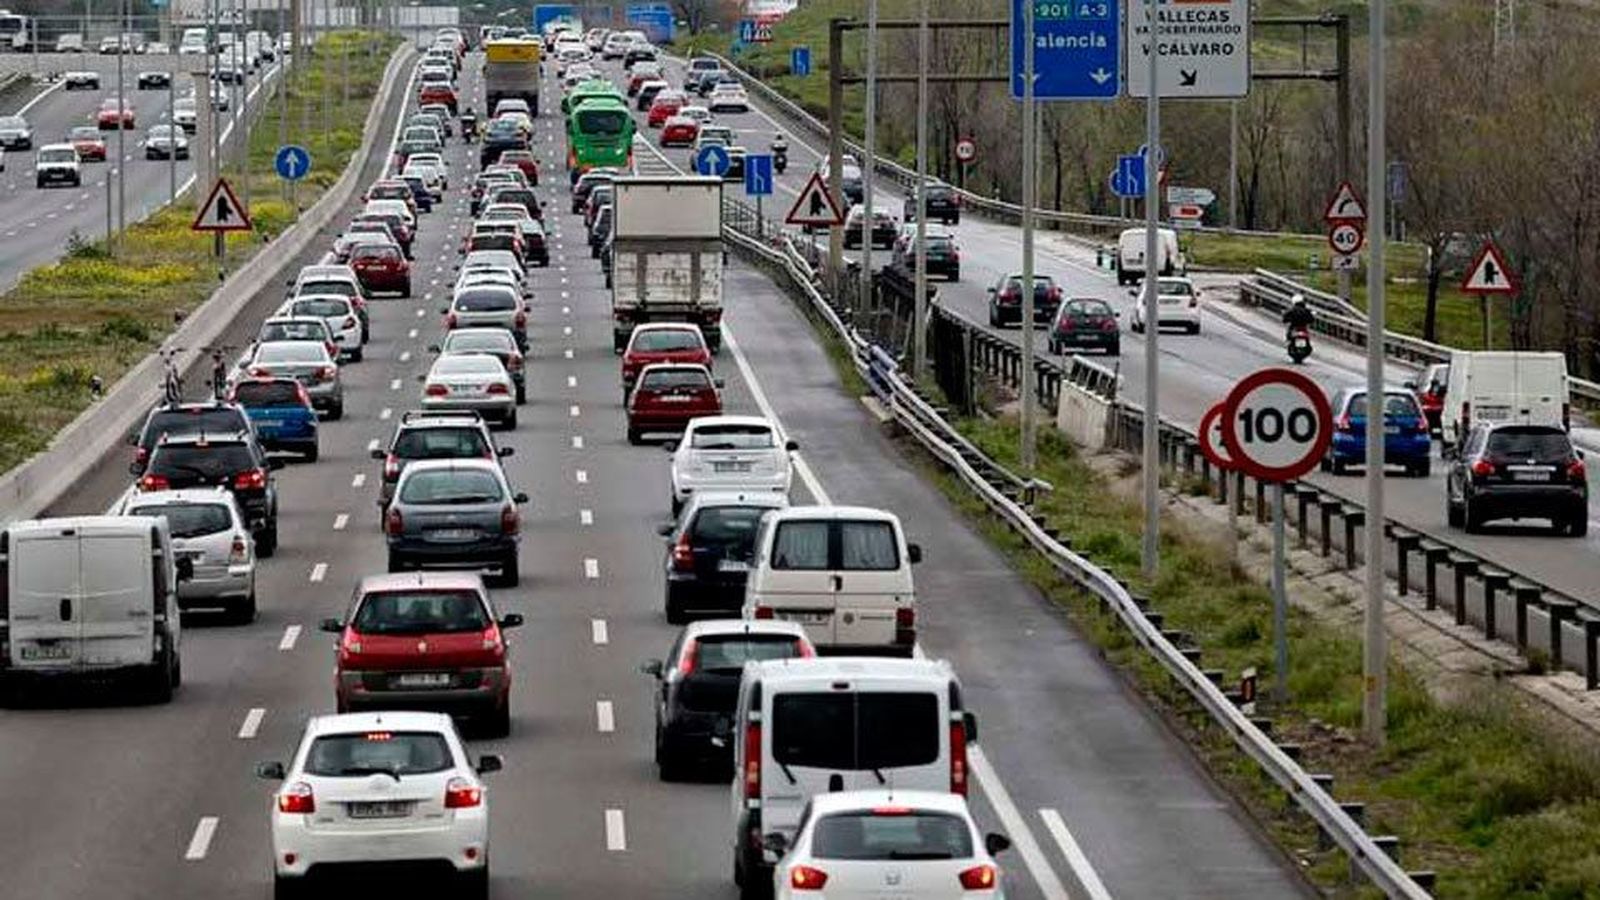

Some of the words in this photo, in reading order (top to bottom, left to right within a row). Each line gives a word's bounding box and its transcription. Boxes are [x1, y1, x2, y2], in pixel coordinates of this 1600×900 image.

[1135, 25, 1241, 35] VADEBERNARDO
[1033, 32, 1107, 48] alencia
[1335, 231, 1356, 244] 40
[1238, 407, 1317, 443] 100
